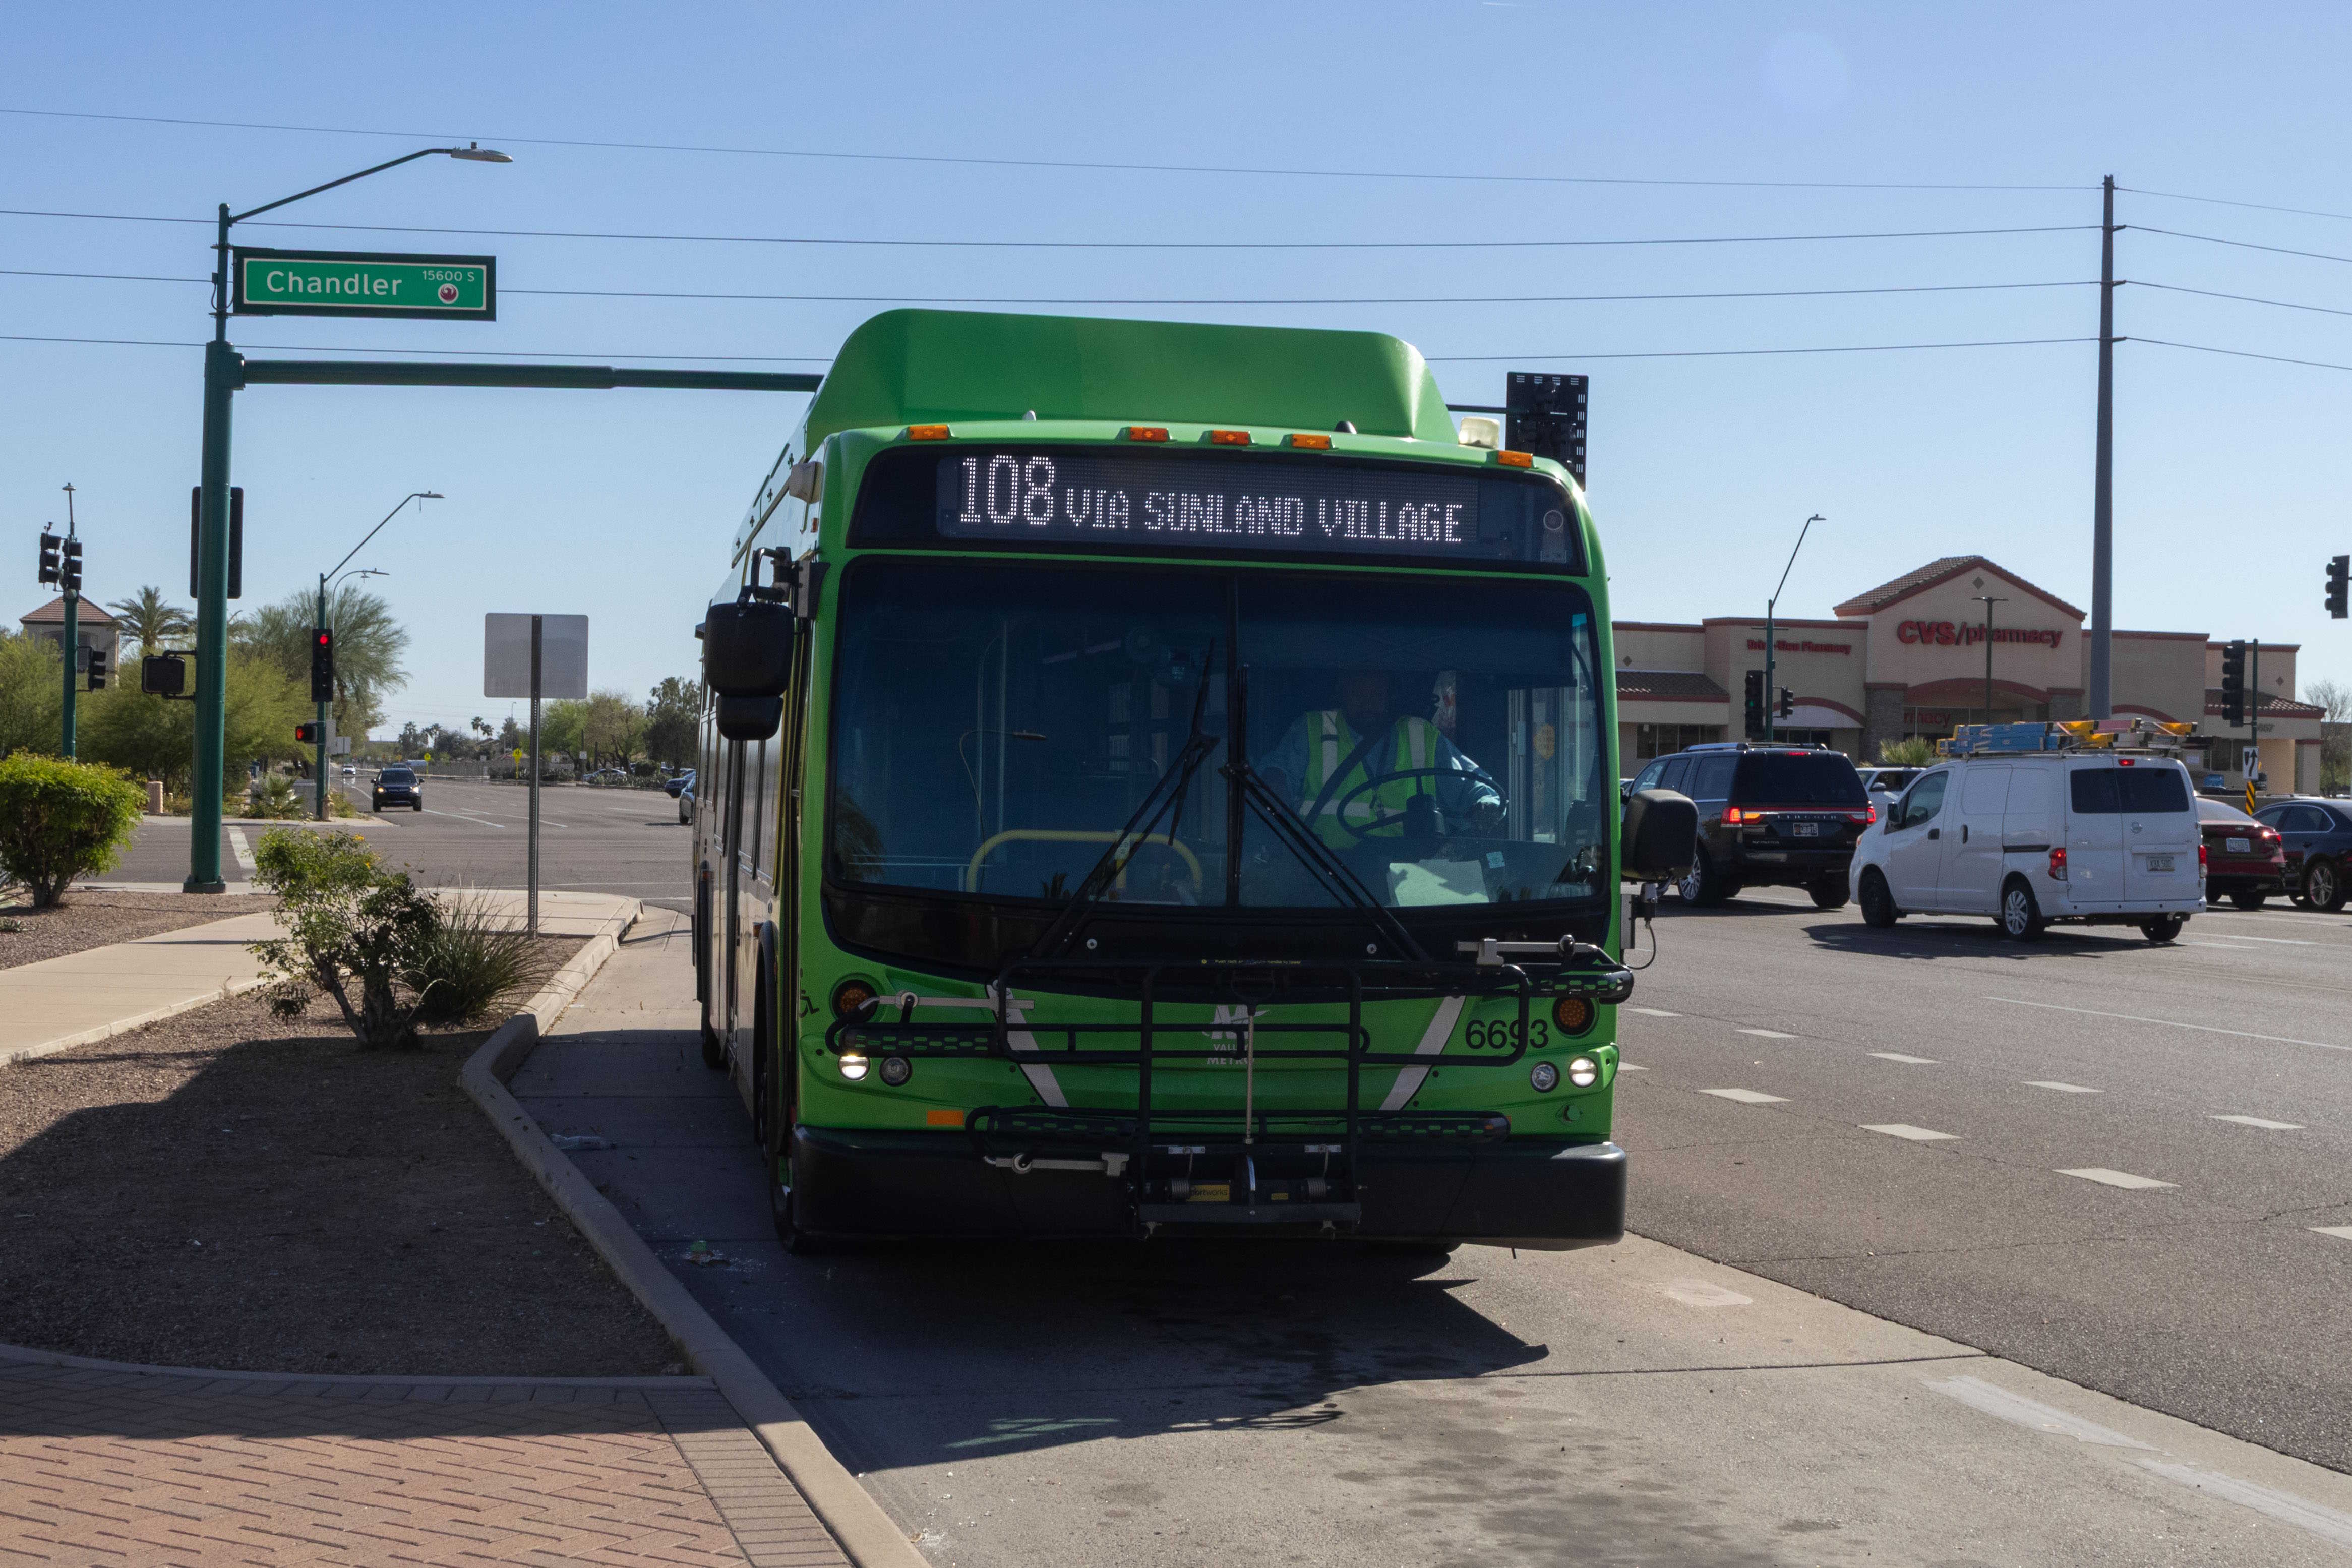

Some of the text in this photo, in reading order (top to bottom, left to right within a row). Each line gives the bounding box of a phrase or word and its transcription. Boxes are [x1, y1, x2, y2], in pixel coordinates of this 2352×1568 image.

[266, 270, 402, 295] Chandler
[422, 270, 475, 282] 15600 S
[960, 455, 1462, 542] 108 VIA SUNLAND VILLAGE
[1801, 641, 1852, 655] Pharmacy
[1465, 1019, 1549, 1050] 6693
